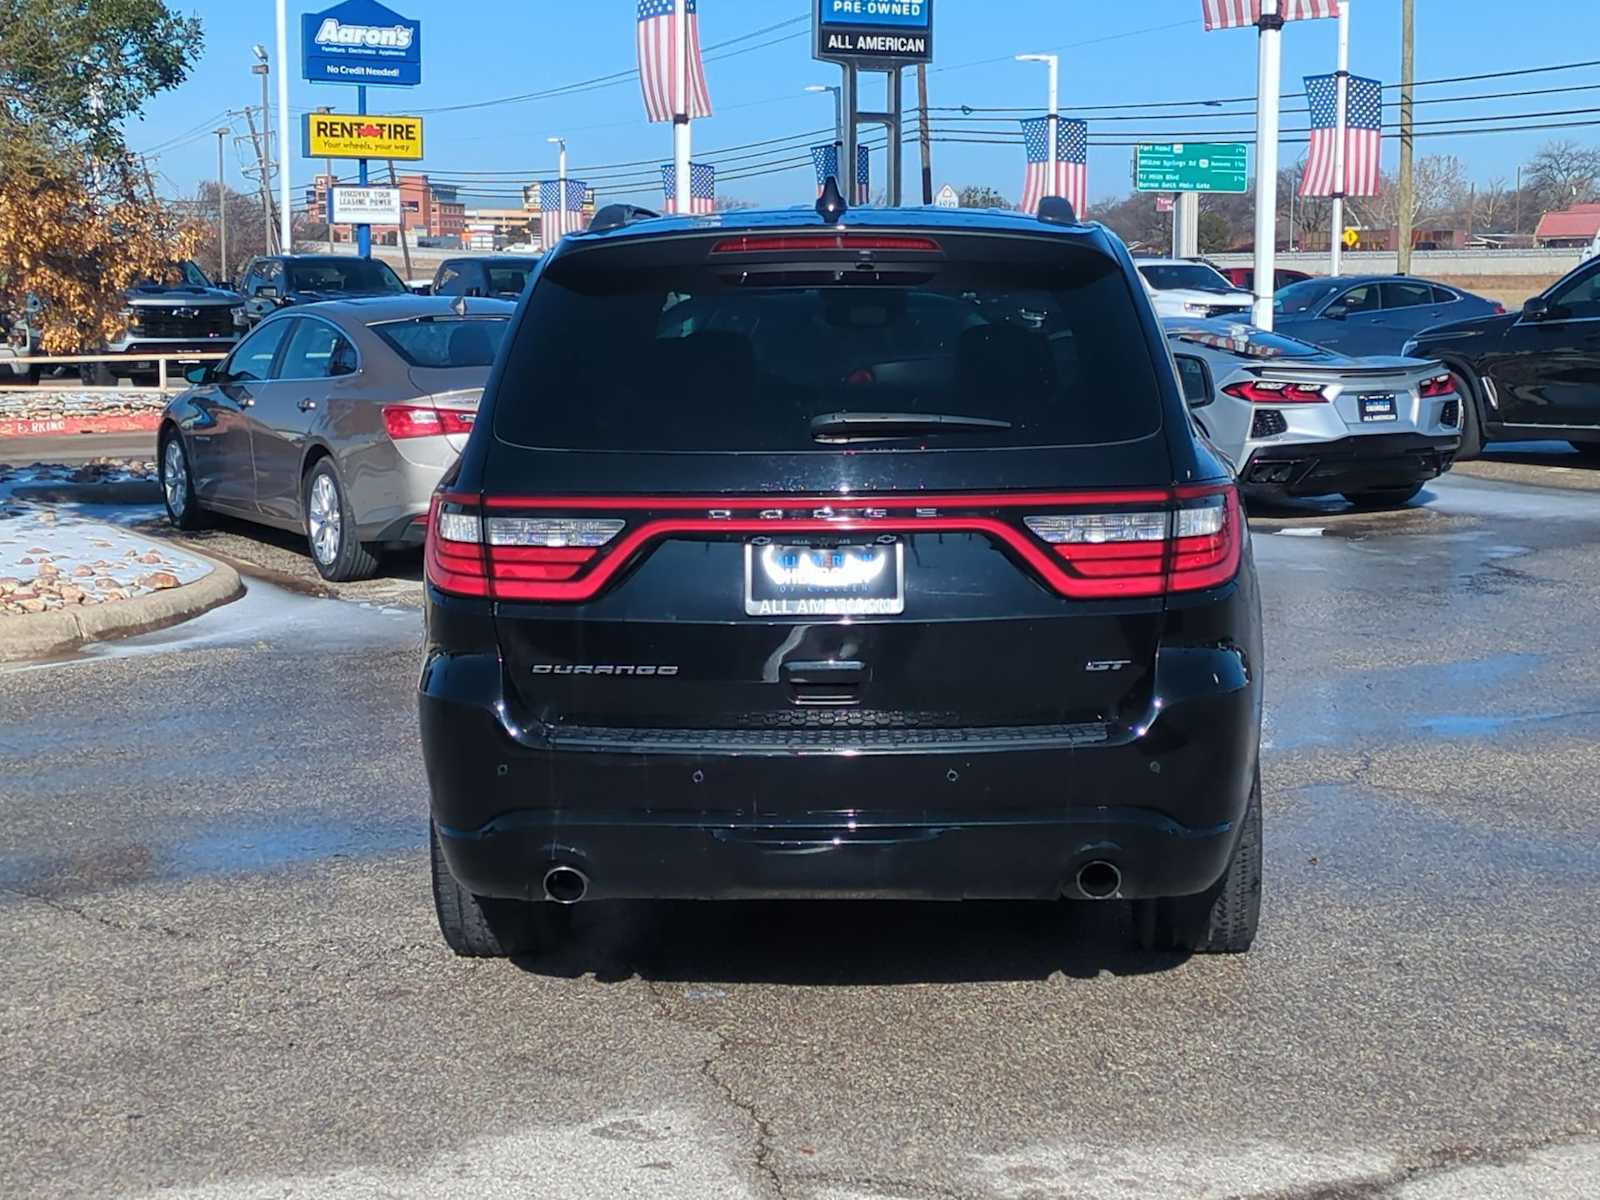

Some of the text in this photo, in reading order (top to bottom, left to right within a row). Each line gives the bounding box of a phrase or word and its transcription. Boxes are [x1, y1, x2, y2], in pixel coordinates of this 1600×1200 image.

[833, 1, 920, 16] PRE-OWNED
[315, 18, 413, 49] Aaron's
[828, 34, 925, 52] ALL AMERICAN
[326, 65, 400, 77] No Credit Needed!
[317, 121, 416, 140] RENT TIRE
[323, 140, 341, 149] Your
[395, 144, 410, 152] way
[709, 508, 937, 520] DODGE
[759, 599, 793, 614] ALL
[532, 664, 678, 675] DURANGO
